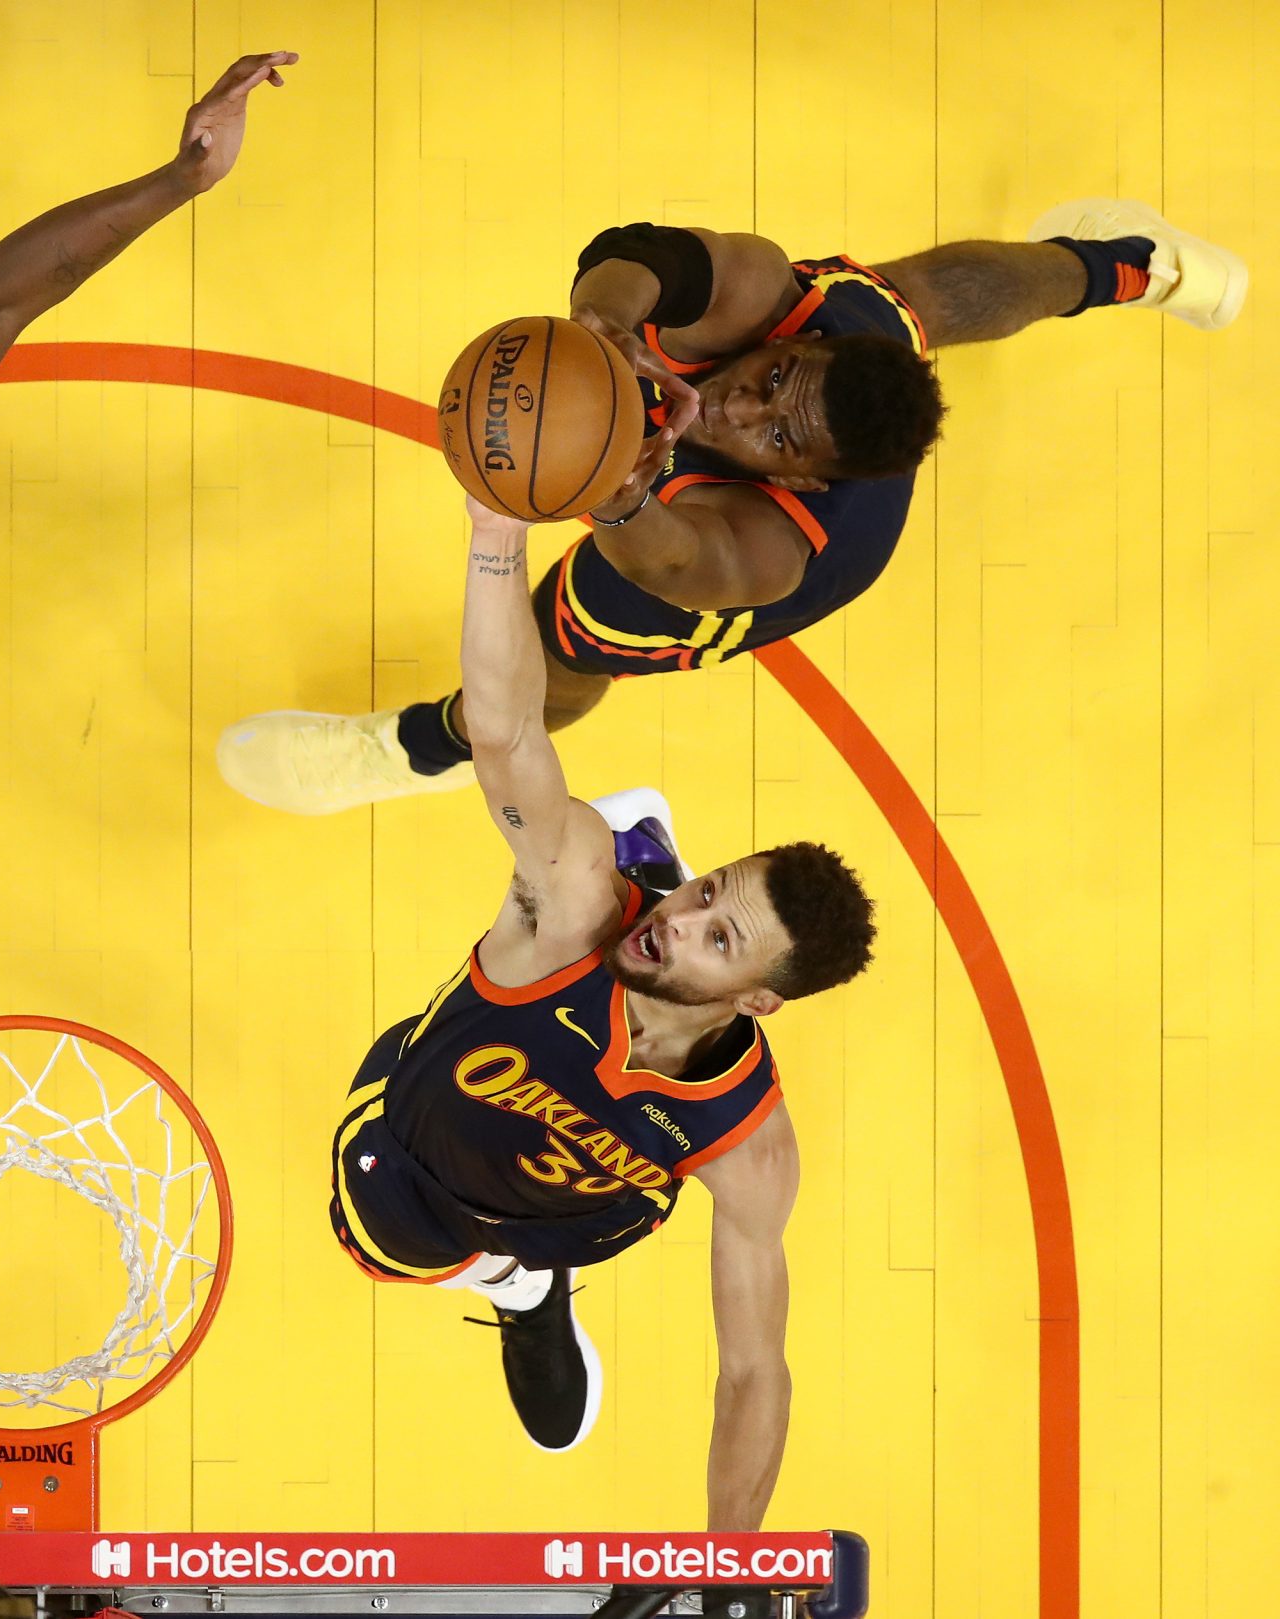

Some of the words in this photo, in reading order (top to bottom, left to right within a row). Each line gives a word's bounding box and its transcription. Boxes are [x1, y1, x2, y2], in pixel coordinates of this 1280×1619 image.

[484, 334, 529, 473] SPALDING
[453, 1043, 671, 1190] OAKLAND
[641, 1104, 691, 1151] Rakuten
[147, 1541, 396, 1578] Hotels.com
